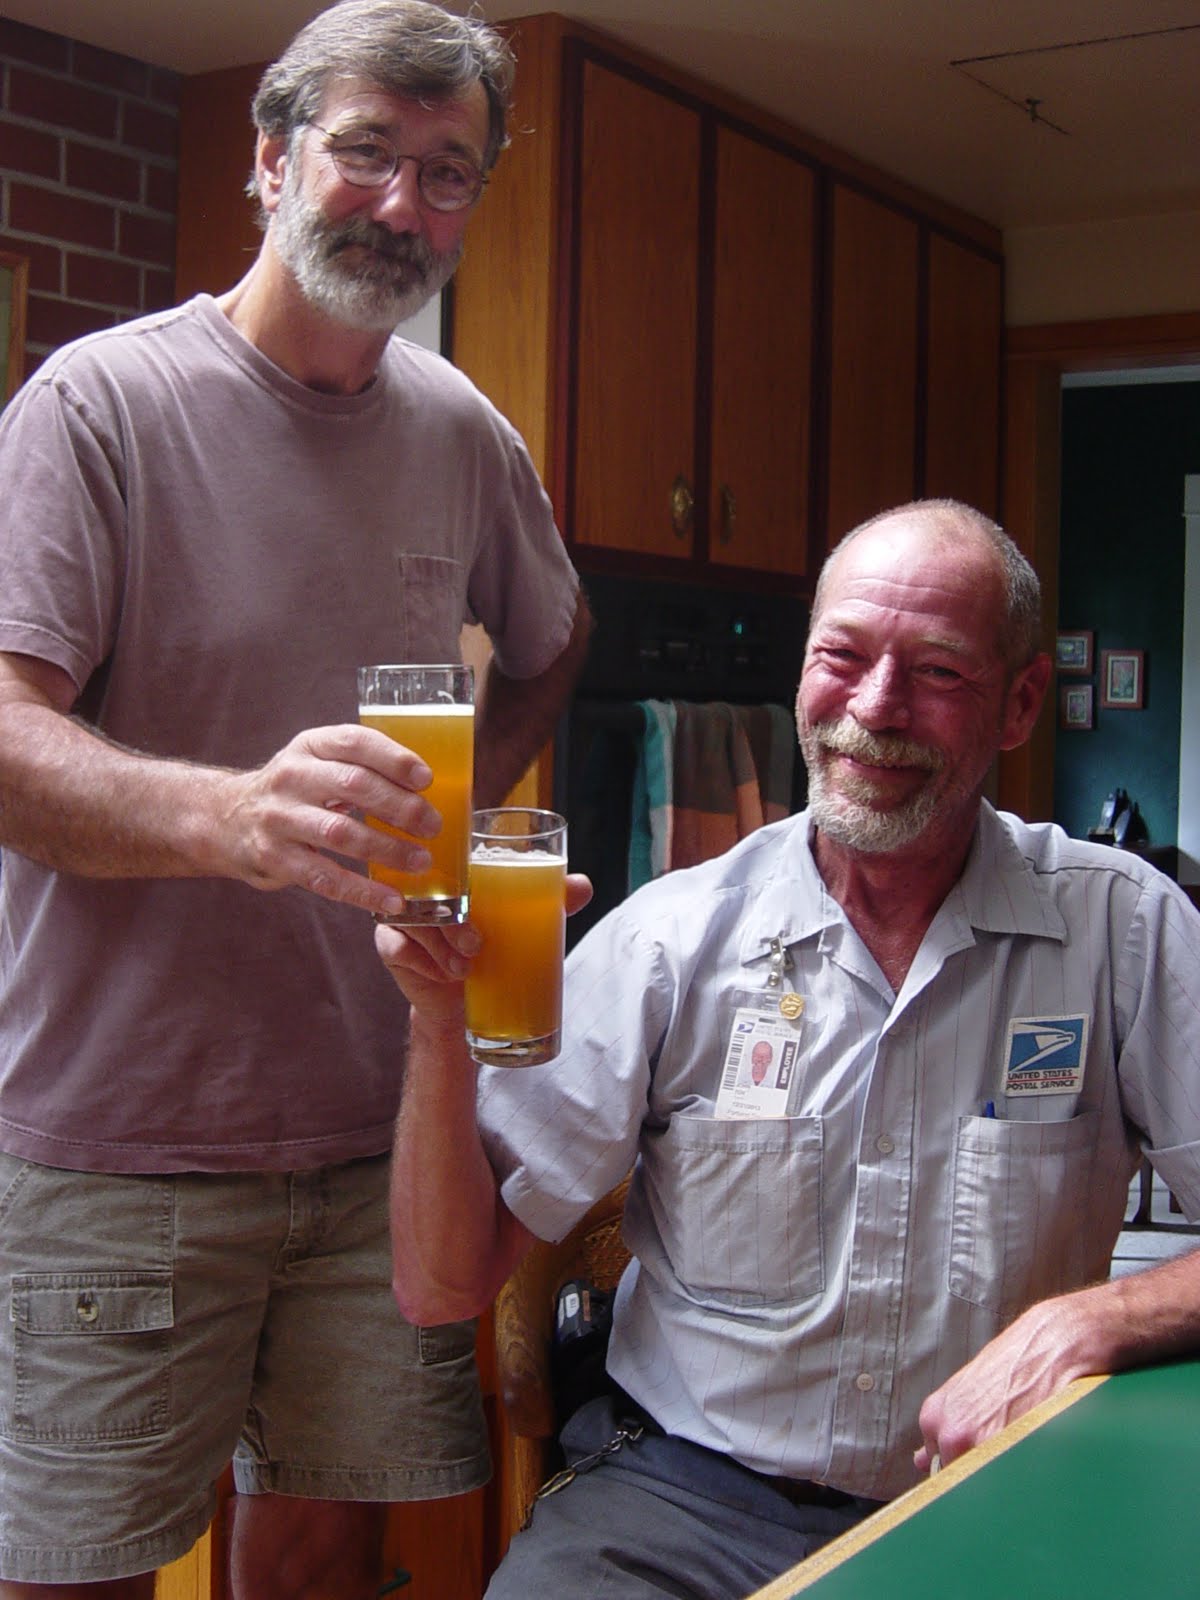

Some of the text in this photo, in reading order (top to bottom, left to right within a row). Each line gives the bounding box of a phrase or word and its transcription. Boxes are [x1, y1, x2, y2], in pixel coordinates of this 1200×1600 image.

[780, 1046, 794, 1084] EMPLOYEE
[1007, 1069, 1073, 1080] UNITED STATES
[1006, 1079, 1075, 1090] POSTAL SERVICE
